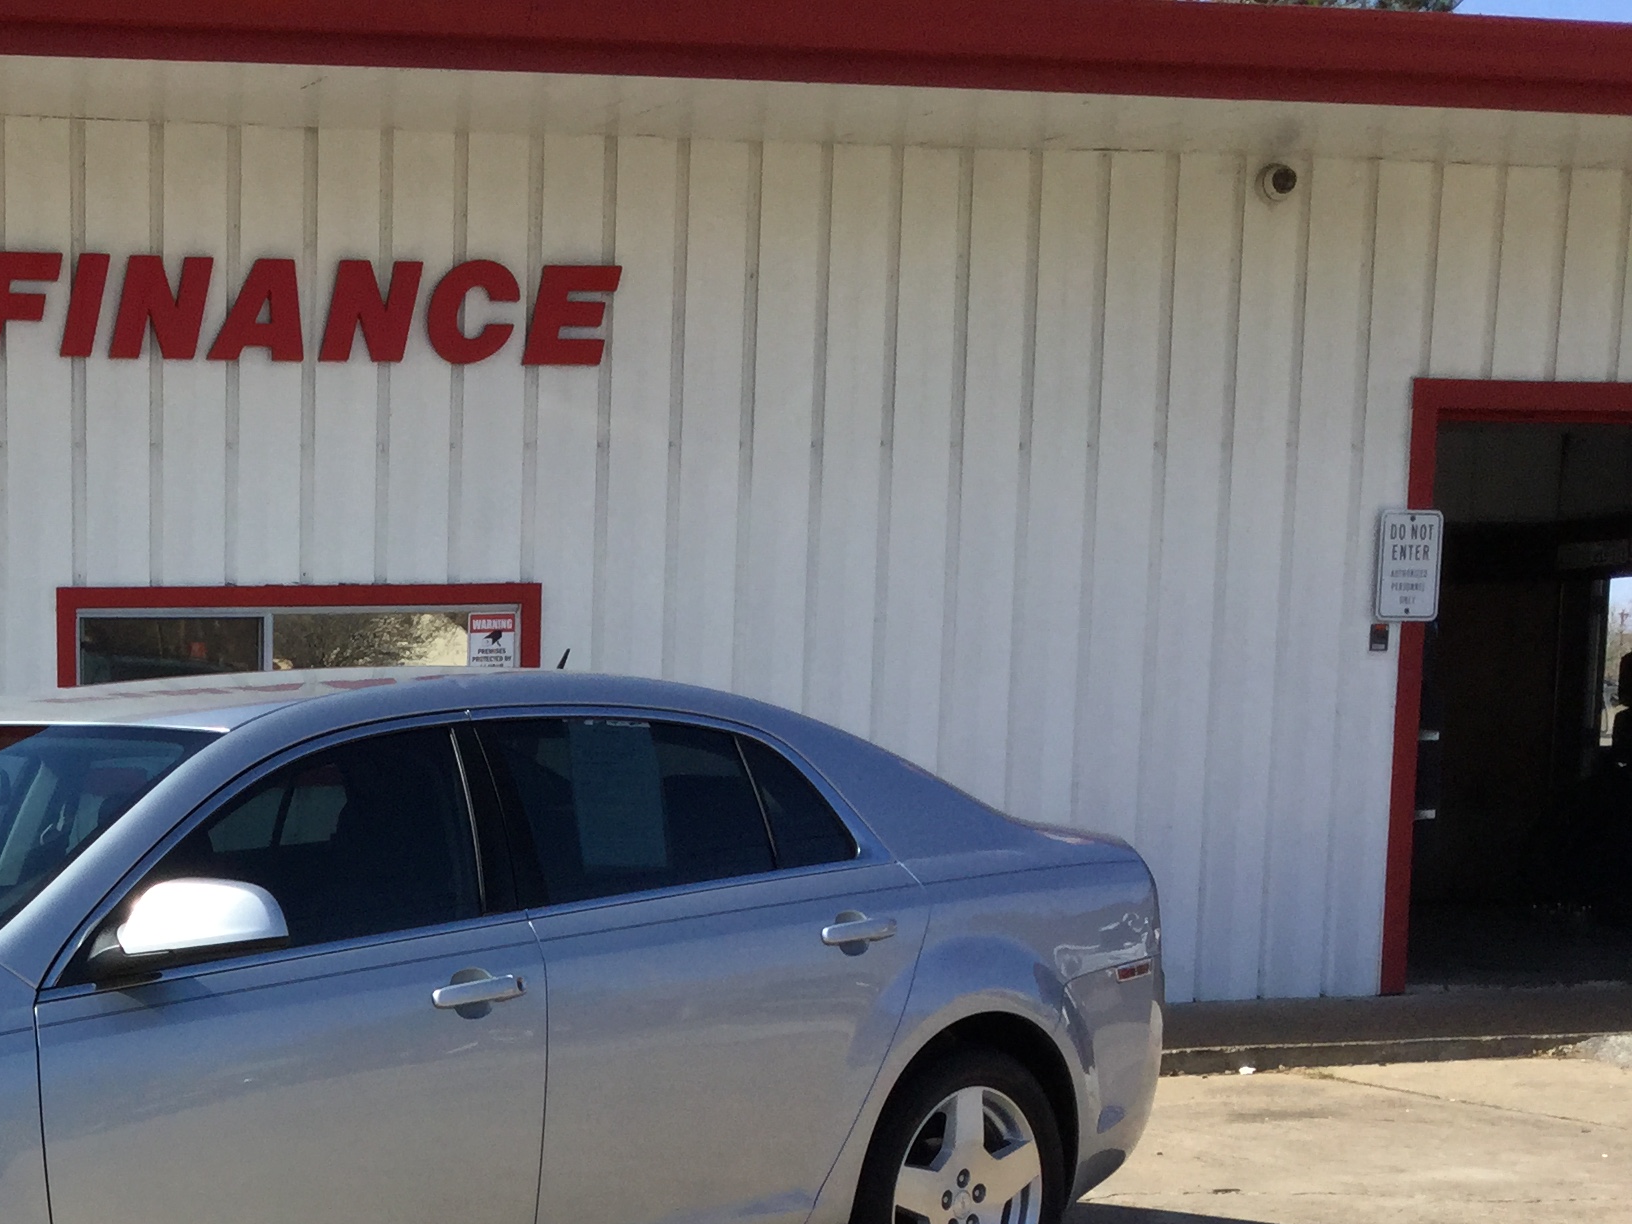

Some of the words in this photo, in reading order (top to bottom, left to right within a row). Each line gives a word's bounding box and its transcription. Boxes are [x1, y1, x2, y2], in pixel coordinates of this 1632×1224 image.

[1390, 523, 1407, 540] DO
[1410, 523, 1435, 541] NOT
[1391, 543, 1430, 561] ENTER
[472, 618, 513, 630] WARNING
[504, 655, 512, 663] BY
